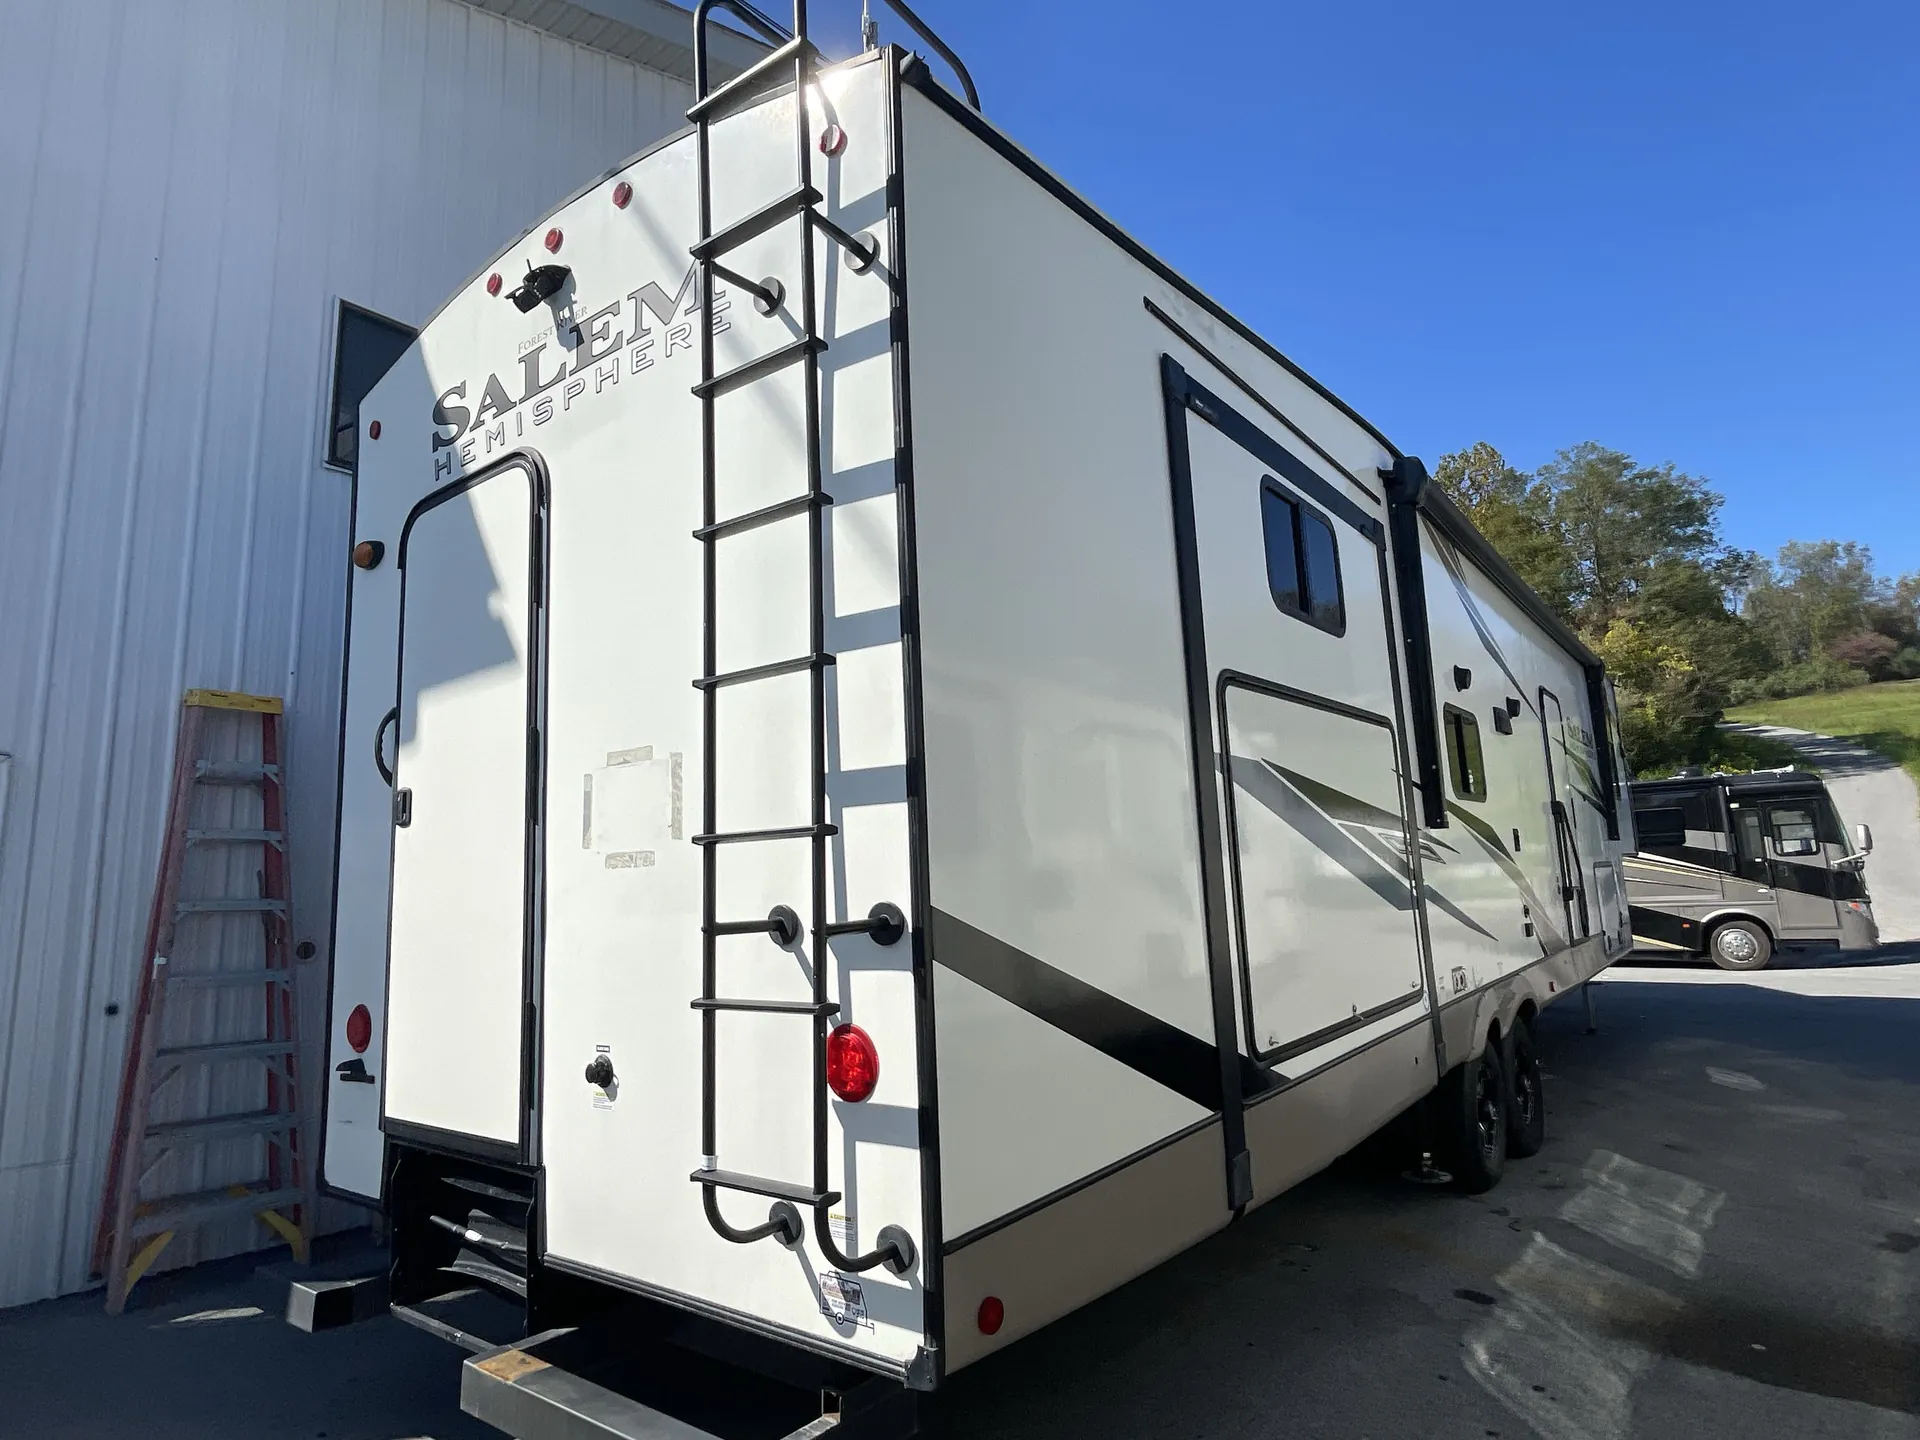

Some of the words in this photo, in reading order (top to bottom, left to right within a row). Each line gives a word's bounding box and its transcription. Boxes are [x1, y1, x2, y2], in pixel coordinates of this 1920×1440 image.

[432, 257, 726, 452] SALEM
[433, 301, 731, 482] HEMISPHERE
[517, 325, 555, 354] FOREST
